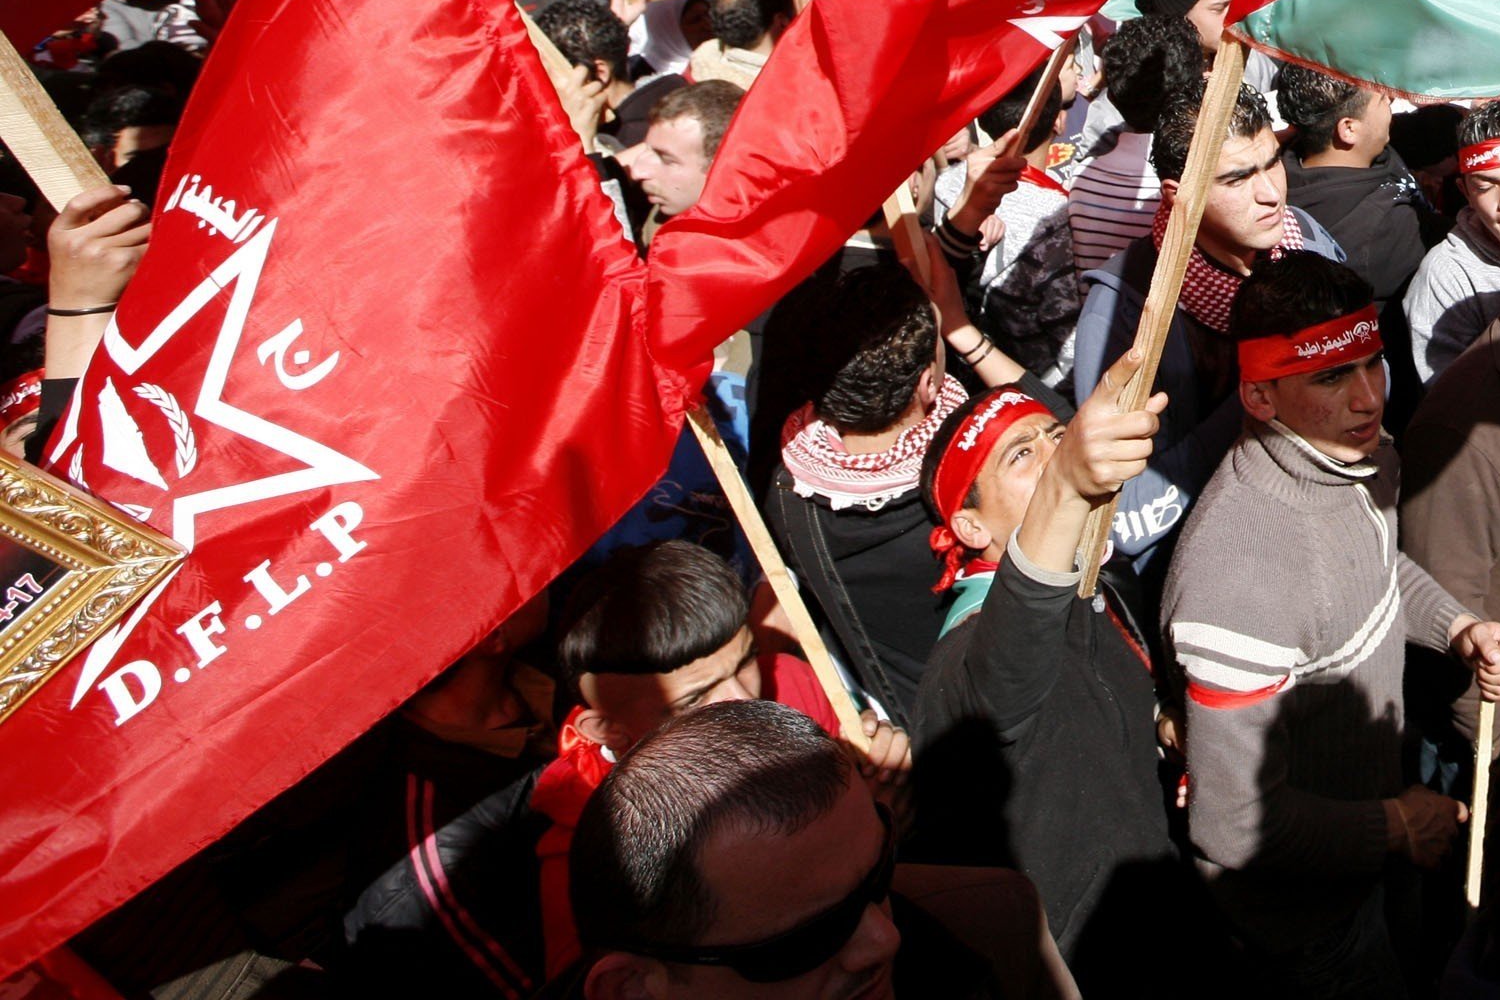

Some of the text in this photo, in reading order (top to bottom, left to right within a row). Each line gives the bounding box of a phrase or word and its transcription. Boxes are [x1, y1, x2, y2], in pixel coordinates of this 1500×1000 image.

[179, 174, 266, 244] الجبهة
[257, 319, 340, 389] ج
[1294, 329, 1355, 358] الديمقراطية
[97, 501, 368, 727] D.F.L.P
